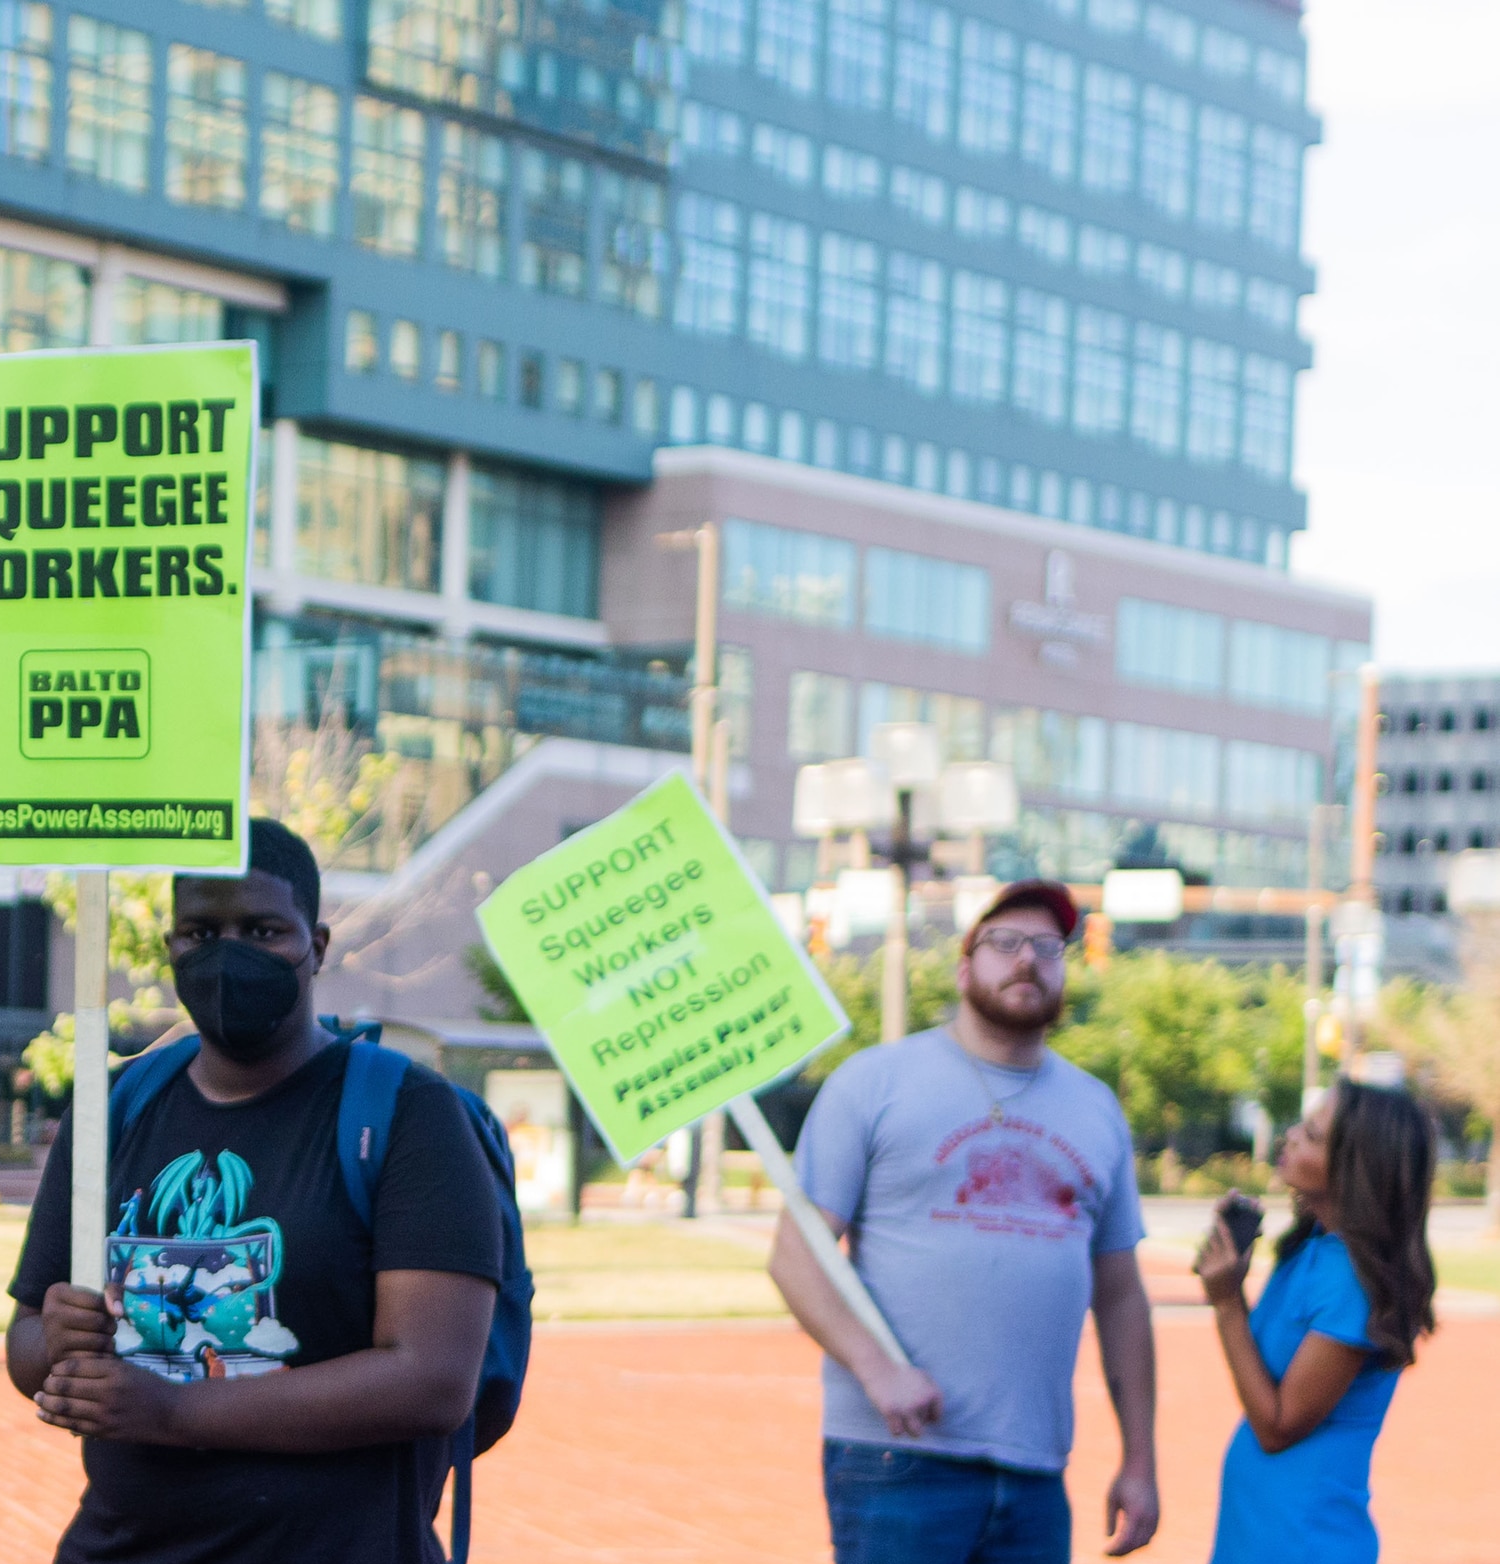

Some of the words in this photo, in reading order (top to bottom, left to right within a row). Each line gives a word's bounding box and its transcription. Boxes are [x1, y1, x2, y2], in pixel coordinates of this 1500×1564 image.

[29, 669, 142, 692] BALTO
[29, 696, 142, 739] PPA
[521, 818, 679, 925] SUPPORT
[539, 858, 705, 962] Squeegee
[572, 903, 714, 988] Workers
[625, 951, 700, 1008] NOT
[591, 949, 772, 1067] Repression
[613, 1037, 712, 1102] Peoples
[716, 985, 793, 1044] Power
